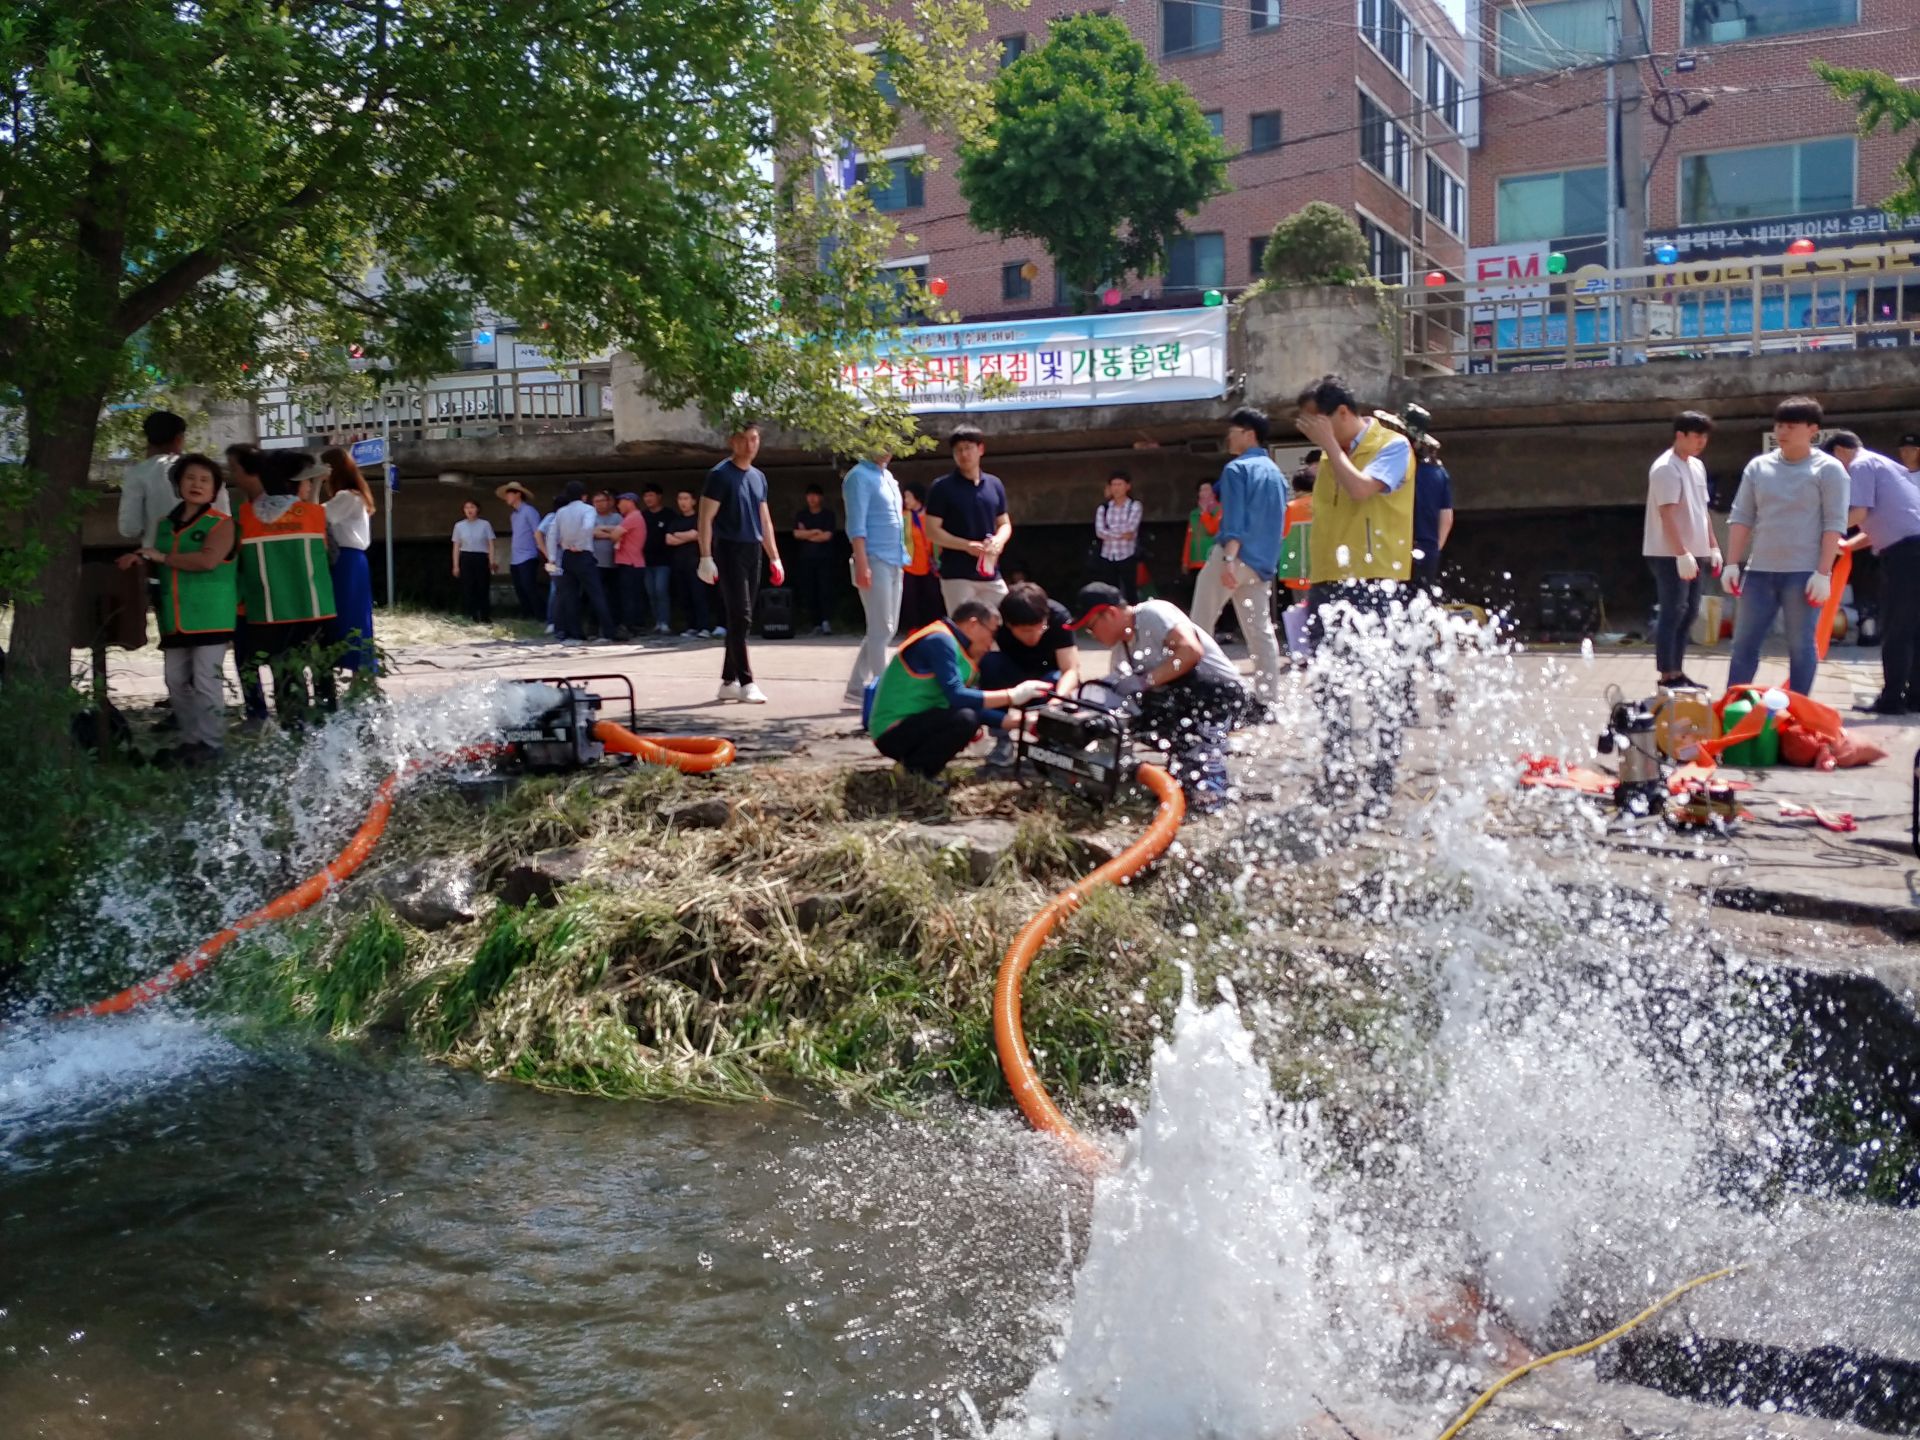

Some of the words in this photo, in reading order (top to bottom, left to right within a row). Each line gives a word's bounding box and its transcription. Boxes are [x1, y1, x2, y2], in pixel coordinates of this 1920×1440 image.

[1477, 253, 1540, 293] FM
[980, 351, 1028, 382] 점검
[1039, 350, 1064, 381] 및
[1072, 341, 1181, 378] 가동훈련
